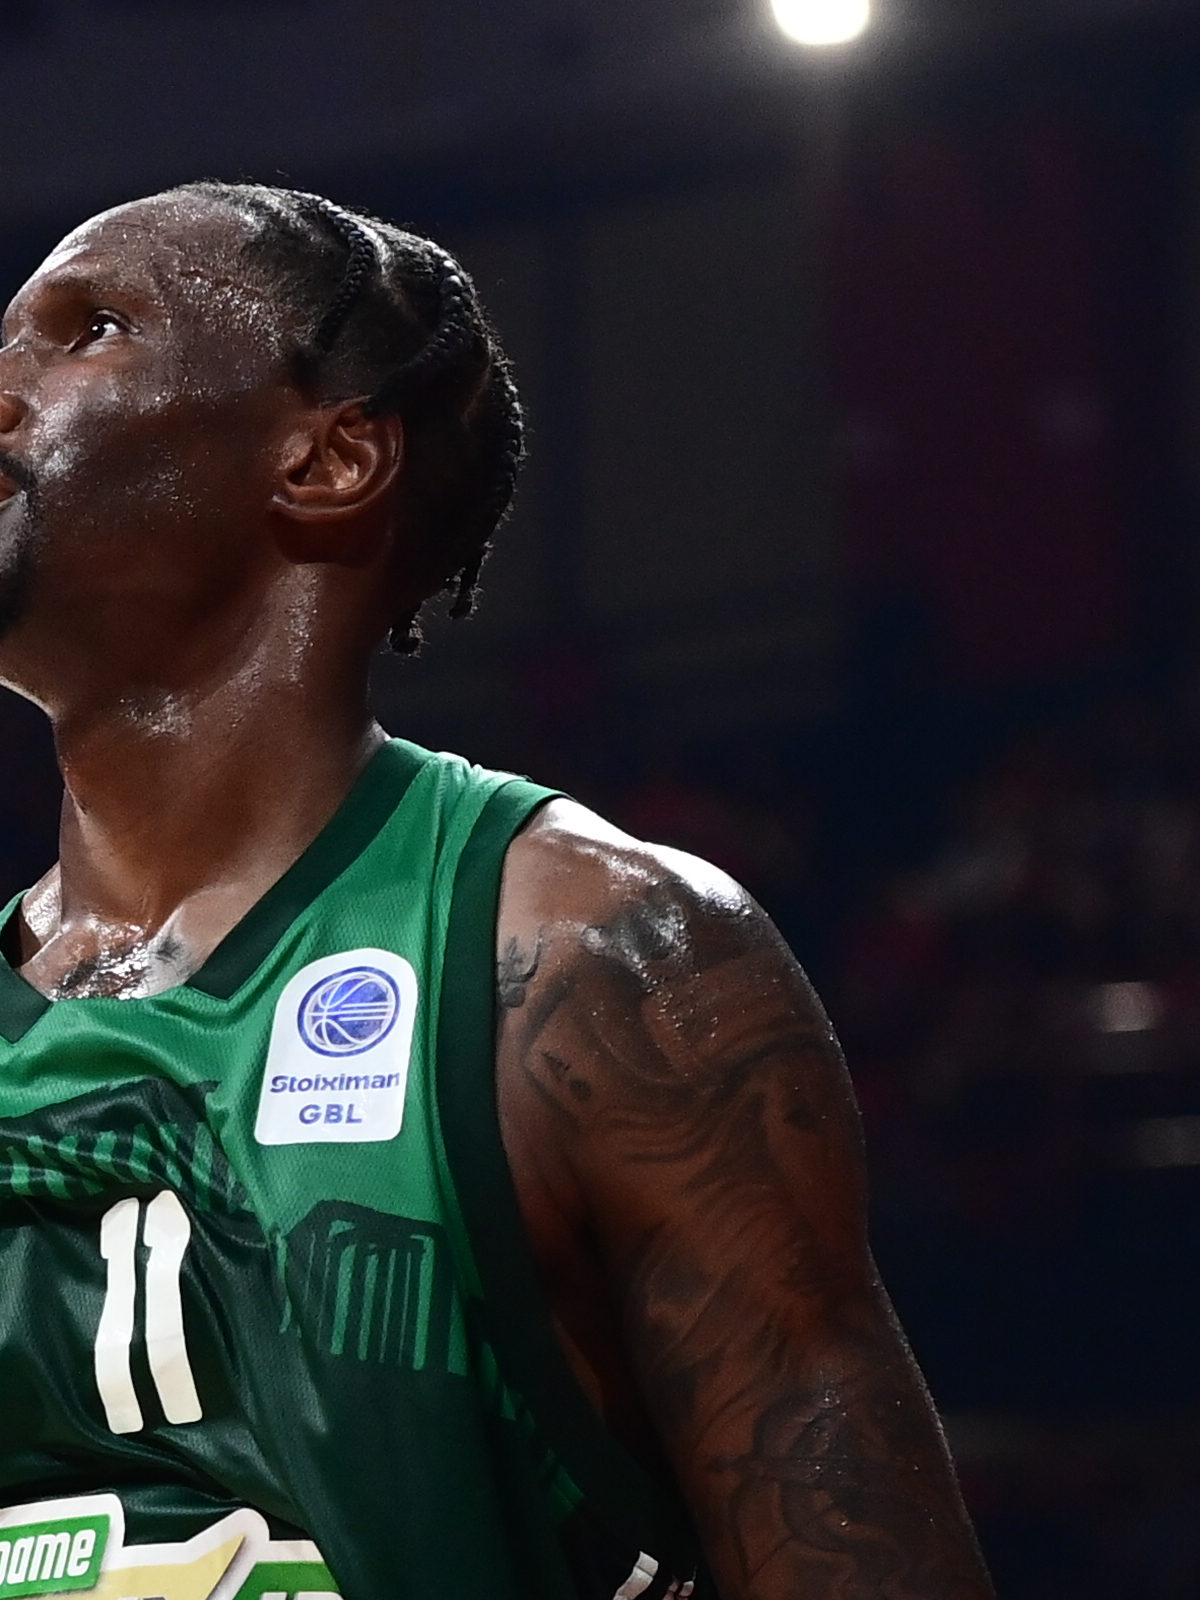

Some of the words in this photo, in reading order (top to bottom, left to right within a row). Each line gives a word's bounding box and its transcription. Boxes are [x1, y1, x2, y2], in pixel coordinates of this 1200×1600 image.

[270, 1072, 401, 1093] Stoiximan
[299, 1103, 363, 1125] GBL
[94, 1189, 203, 1435] 11
